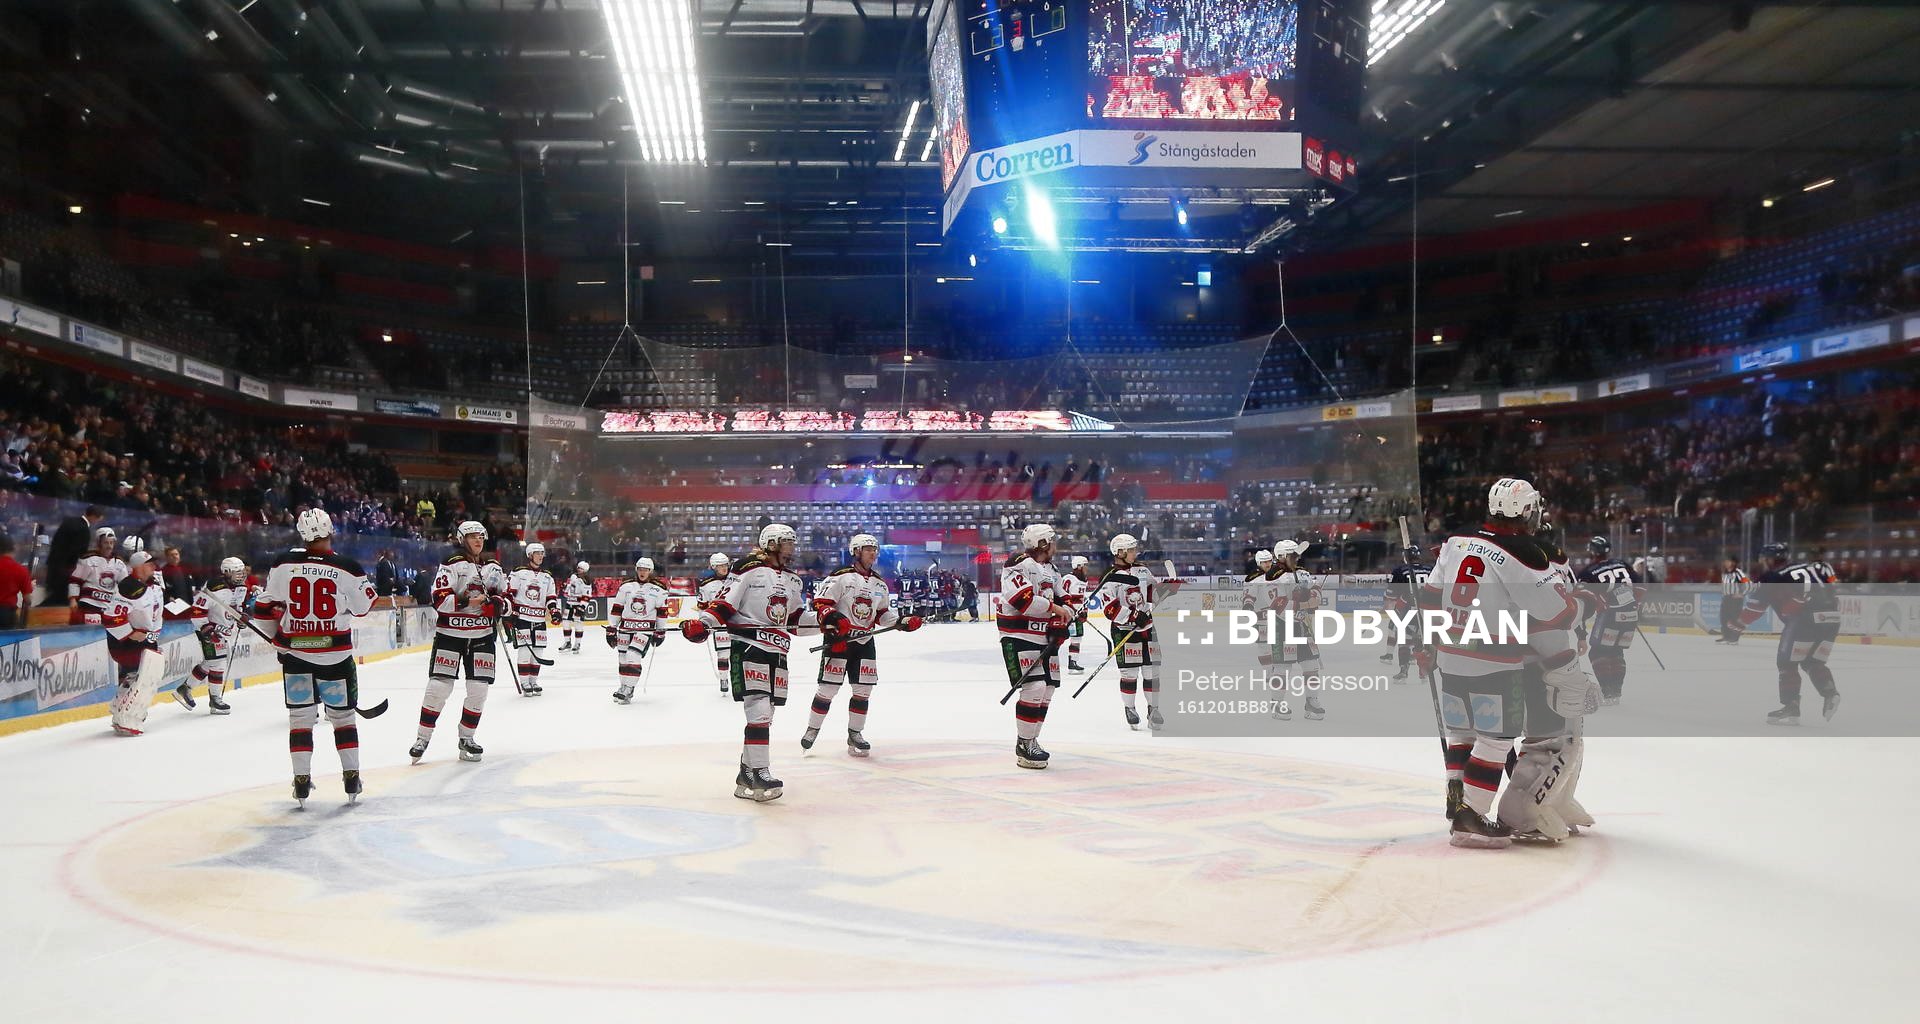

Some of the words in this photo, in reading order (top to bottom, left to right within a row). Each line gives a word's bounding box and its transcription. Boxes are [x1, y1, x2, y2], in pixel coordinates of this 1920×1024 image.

[975, 142, 1074, 182] Corren
[1159, 142, 1256, 161] Stångåstaden
[1467, 541, 1506, 566] bravida
[302, 565, 339, 579] bravida
[435, 574, 449, 589] 63
[1011, 574, 1028, 590] 12
[1450, 555, 1486, 607] 6
[289, 577, 338, 619] 96
[1658, 602, 1694, 615] VIDEO
[758, 629, 791, 650] areco
[37, 651, 97, 700] Reklam
